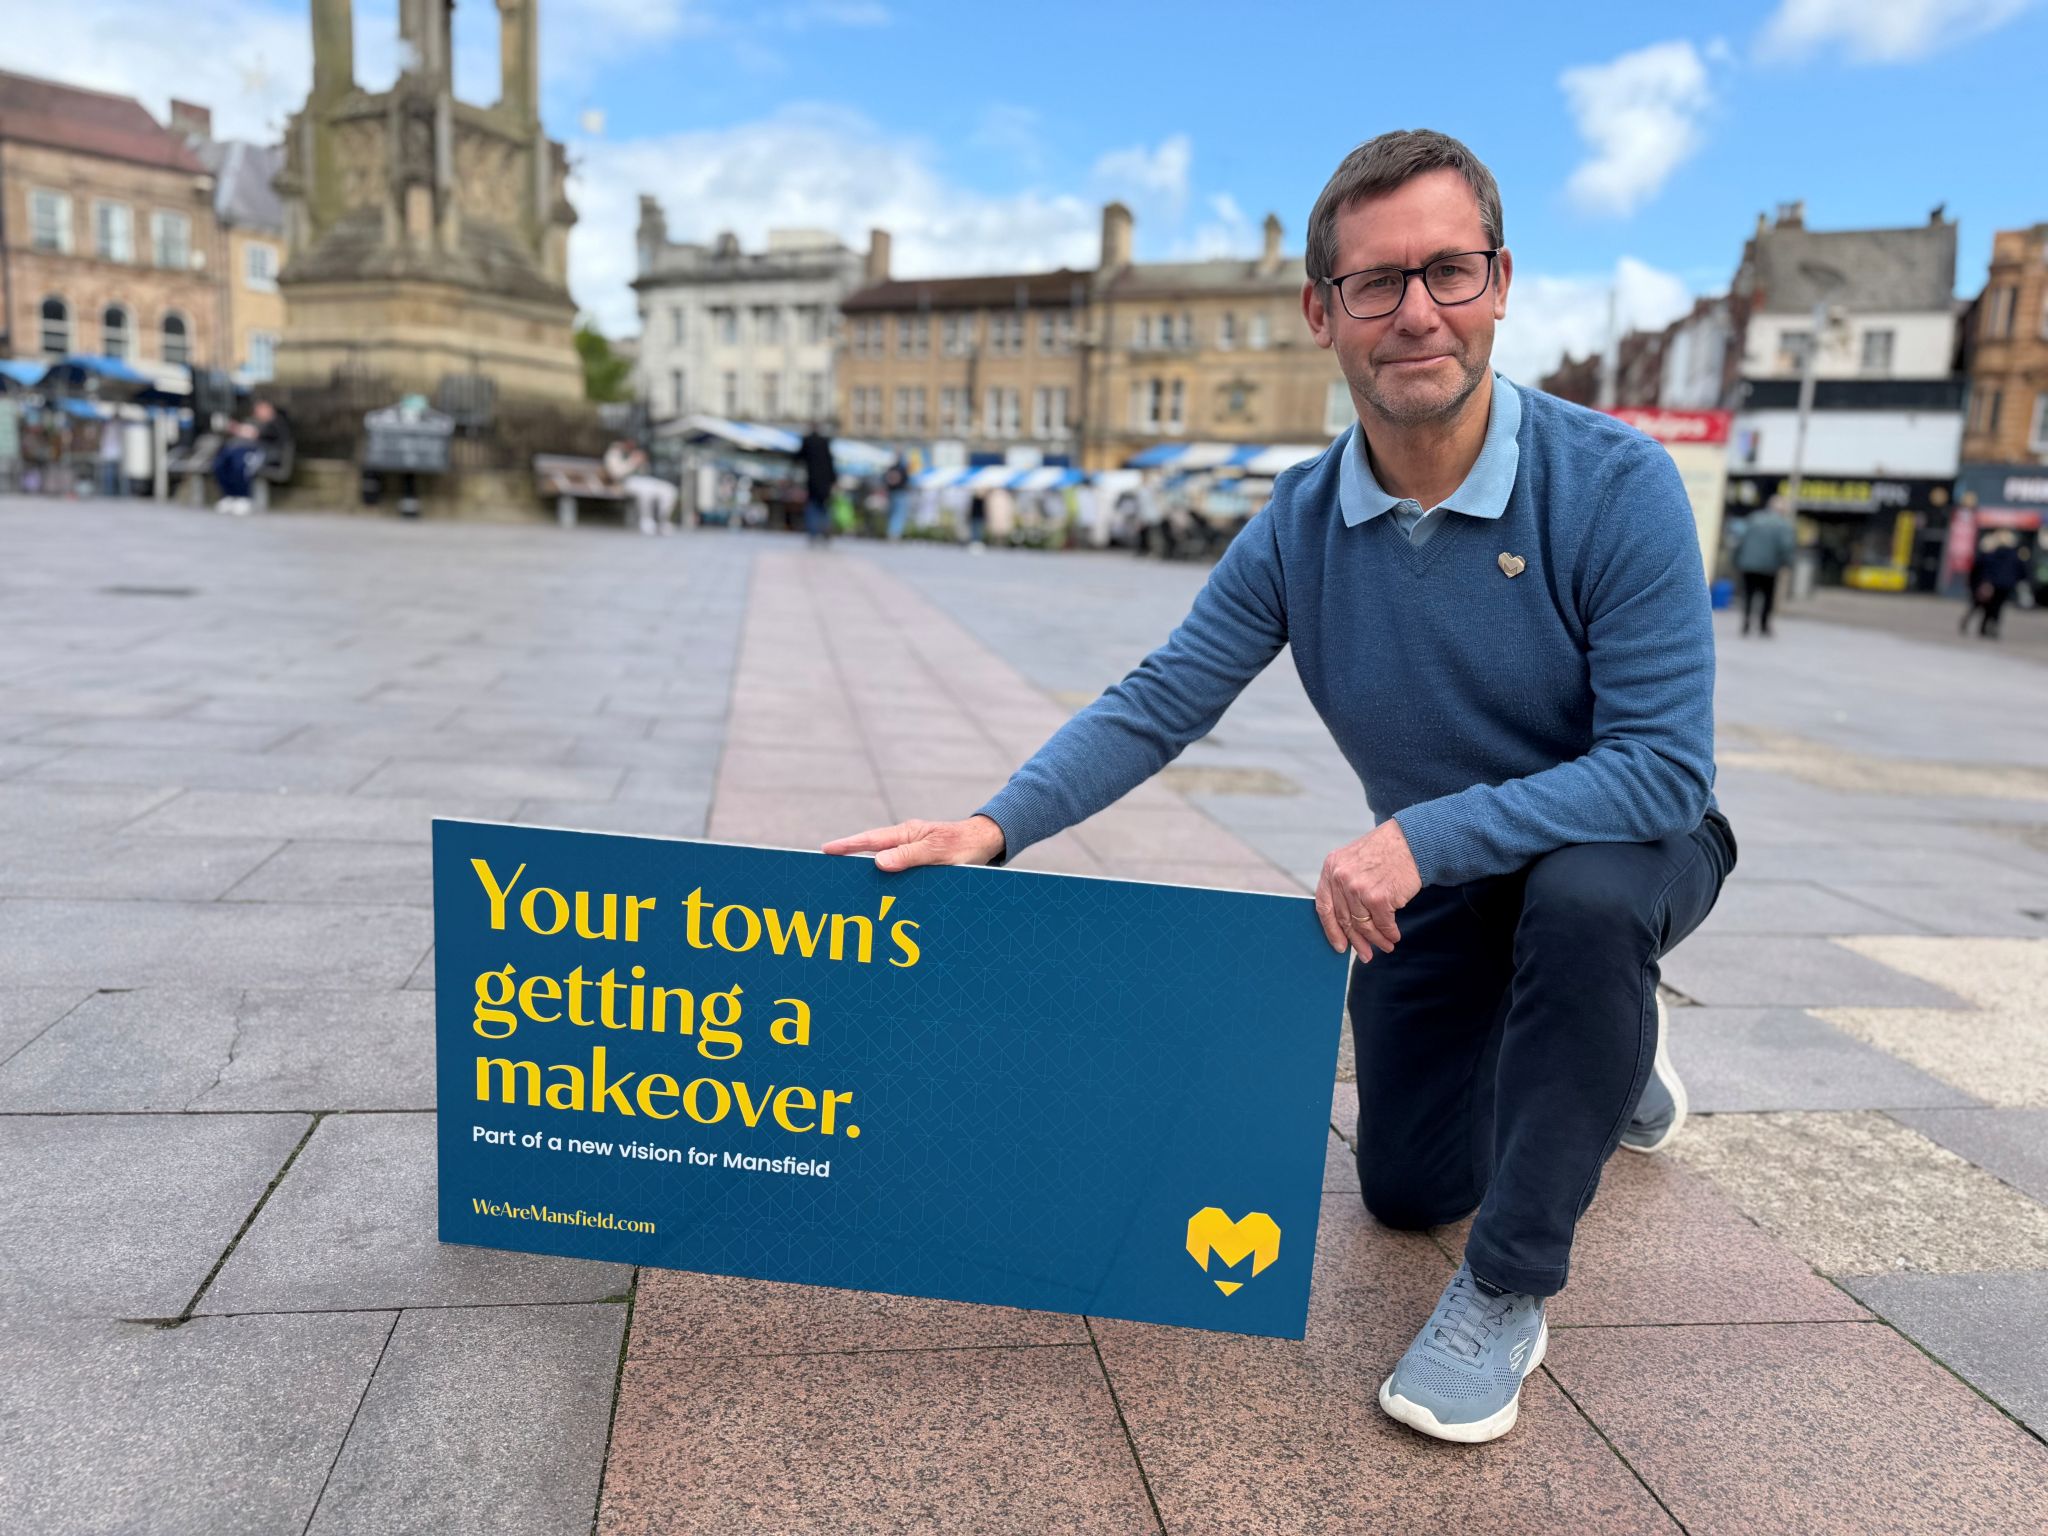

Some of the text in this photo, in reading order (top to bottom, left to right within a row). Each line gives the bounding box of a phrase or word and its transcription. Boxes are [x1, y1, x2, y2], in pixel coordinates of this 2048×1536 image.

[470, 858, 921, 968] Your town's
[472, 962, 811, 1061] getting a
[476, 1045, 861, 1139] makeover.
[472, 1124, 830, 1179] Part of a new vision for Mansfield
[472, 1198, 656, 1234] WeAreMansfield.com
